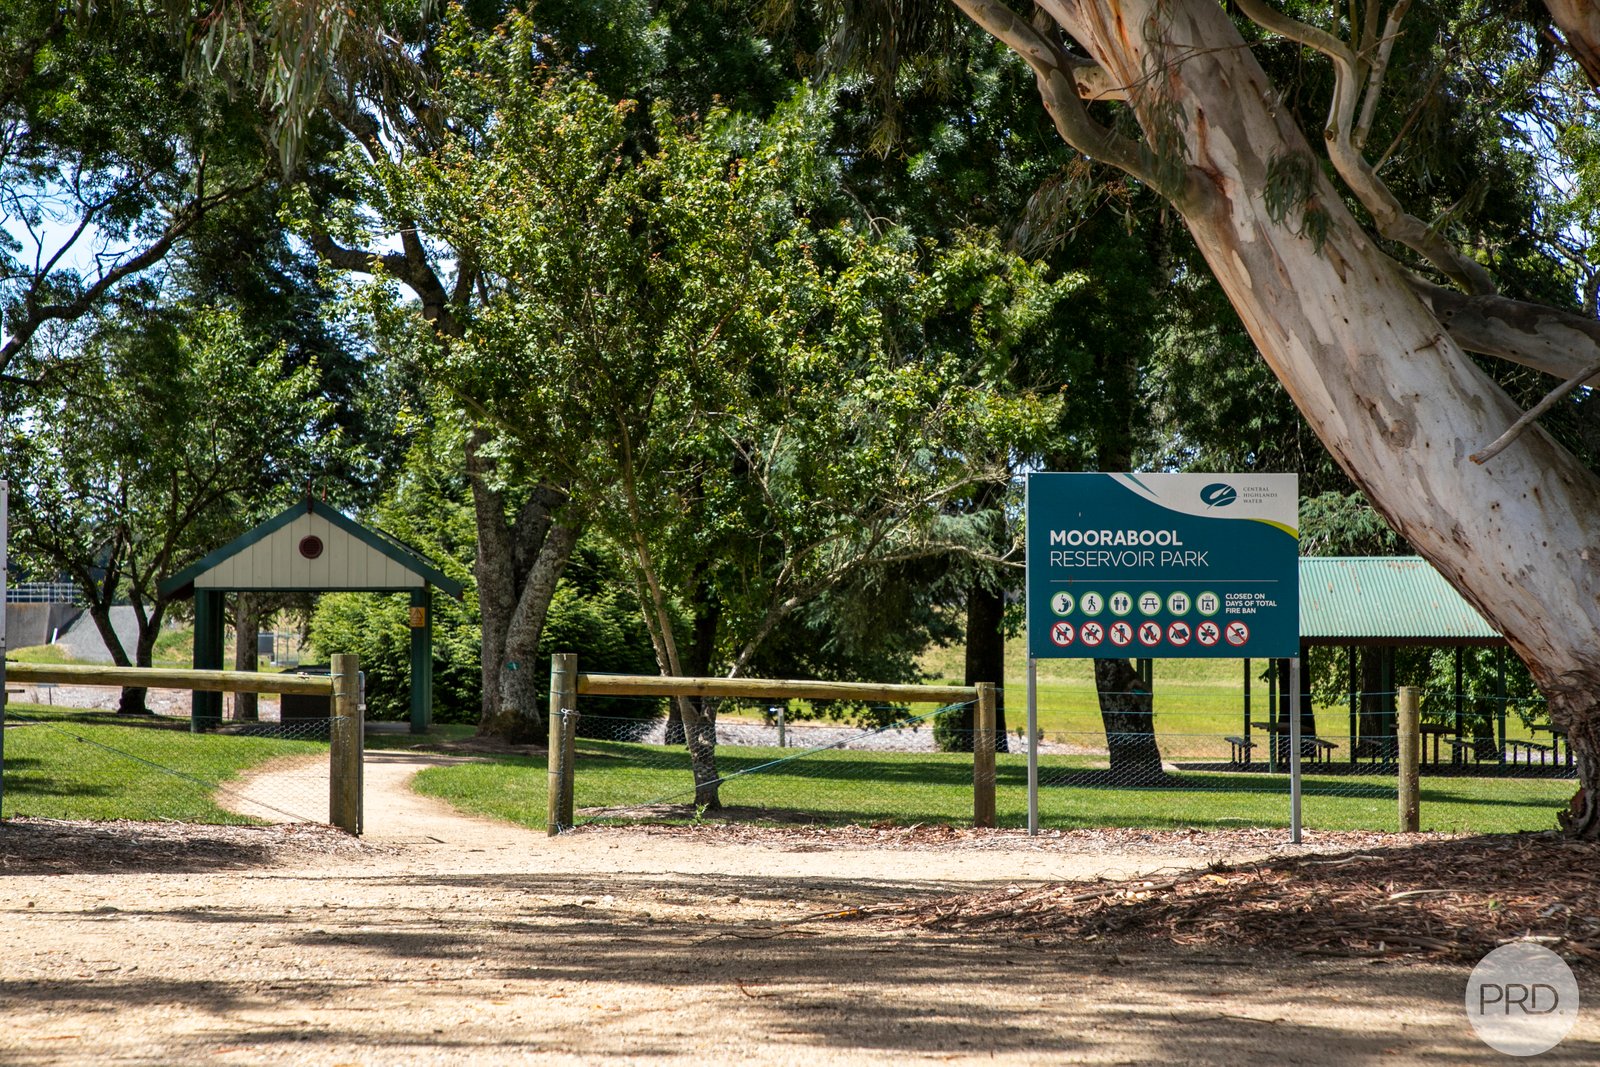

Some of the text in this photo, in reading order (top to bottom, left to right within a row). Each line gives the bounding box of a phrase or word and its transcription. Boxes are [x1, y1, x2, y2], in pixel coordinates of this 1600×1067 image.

[1050, 530, 1183, 546] MOORABOOL
[1050, 551, 1209, 567] RESERVOIR PARK
